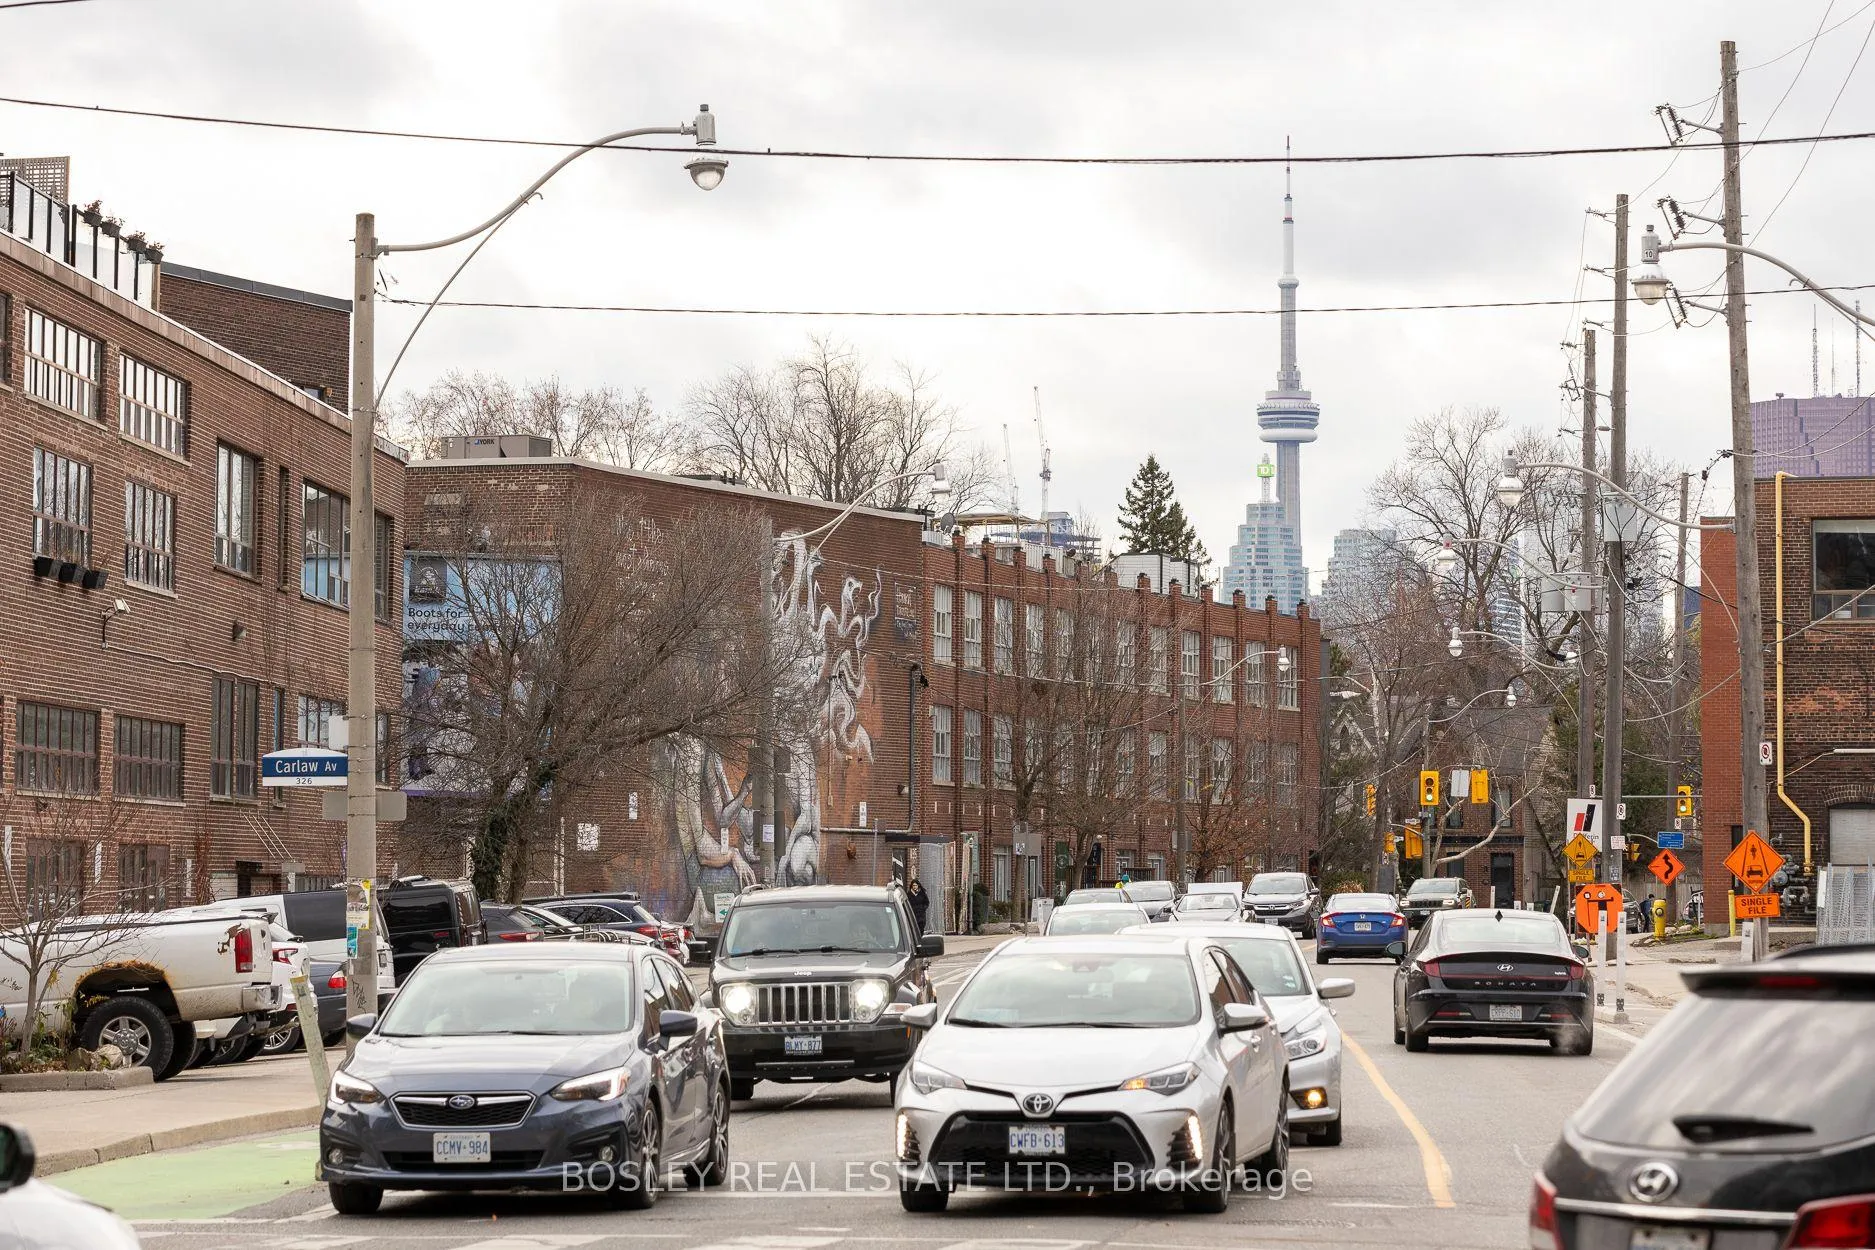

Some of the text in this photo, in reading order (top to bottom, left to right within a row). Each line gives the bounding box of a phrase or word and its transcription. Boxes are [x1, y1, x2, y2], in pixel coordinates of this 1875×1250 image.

[408, 607, 464, 618] Boots for
[407, 619, 466, 633] everyday
[275, 759, 338, 774] Carlaw Av
[296, 777, 313, 785] 326
[1741, 896, 1773, 907] SINGLE
[1748, 906, 1767, 915] FILE
